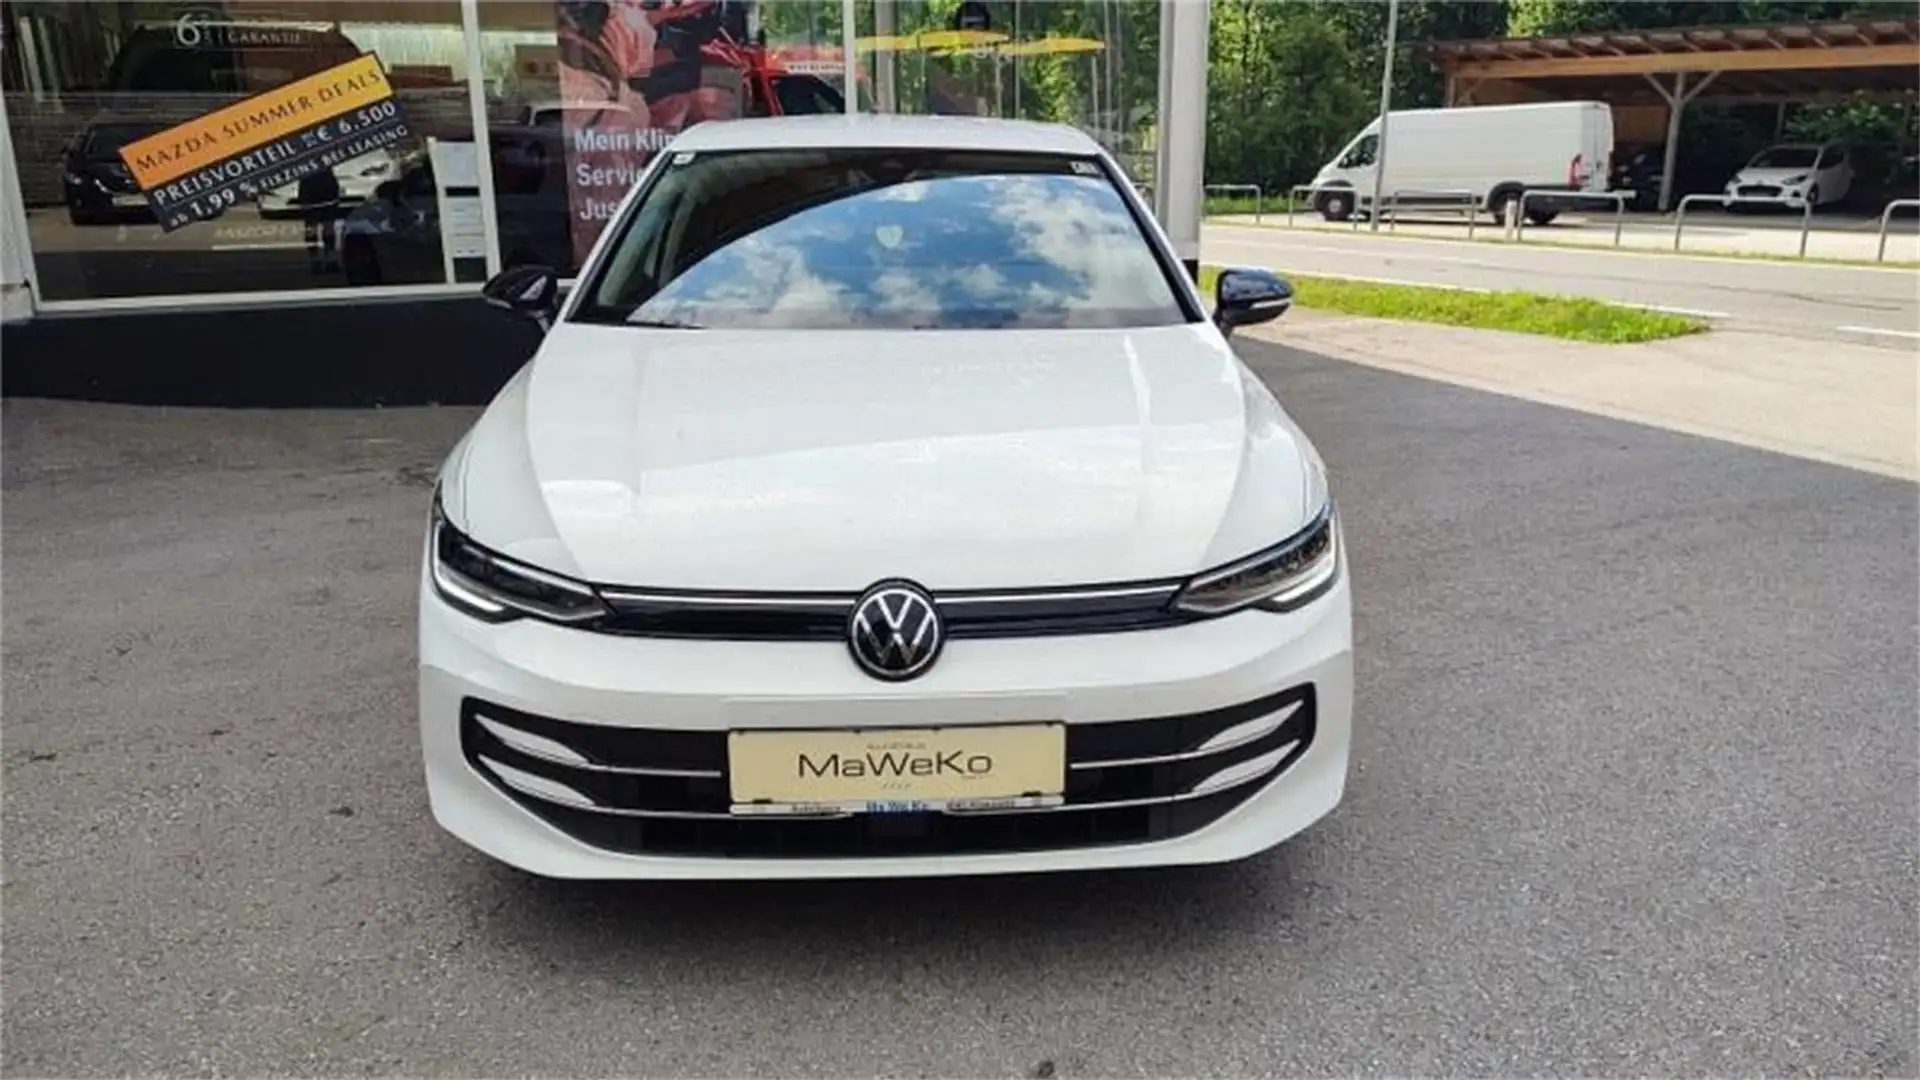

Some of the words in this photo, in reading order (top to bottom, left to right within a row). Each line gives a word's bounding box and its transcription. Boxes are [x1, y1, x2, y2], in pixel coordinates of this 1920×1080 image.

[177, 13, 201, 46] 6
[135, 131, 217, 174] MAZDA
[222, 95, 314, 138] SUMMER
[317, 68, 382, 101] DEALS
[348, 124, 408, 155] LEASING
[574, 128, 630, 152] Mein
[154, 140, 297, 206] PREISVORTEIL
[798, 750, 993, 778] MaWeKo
